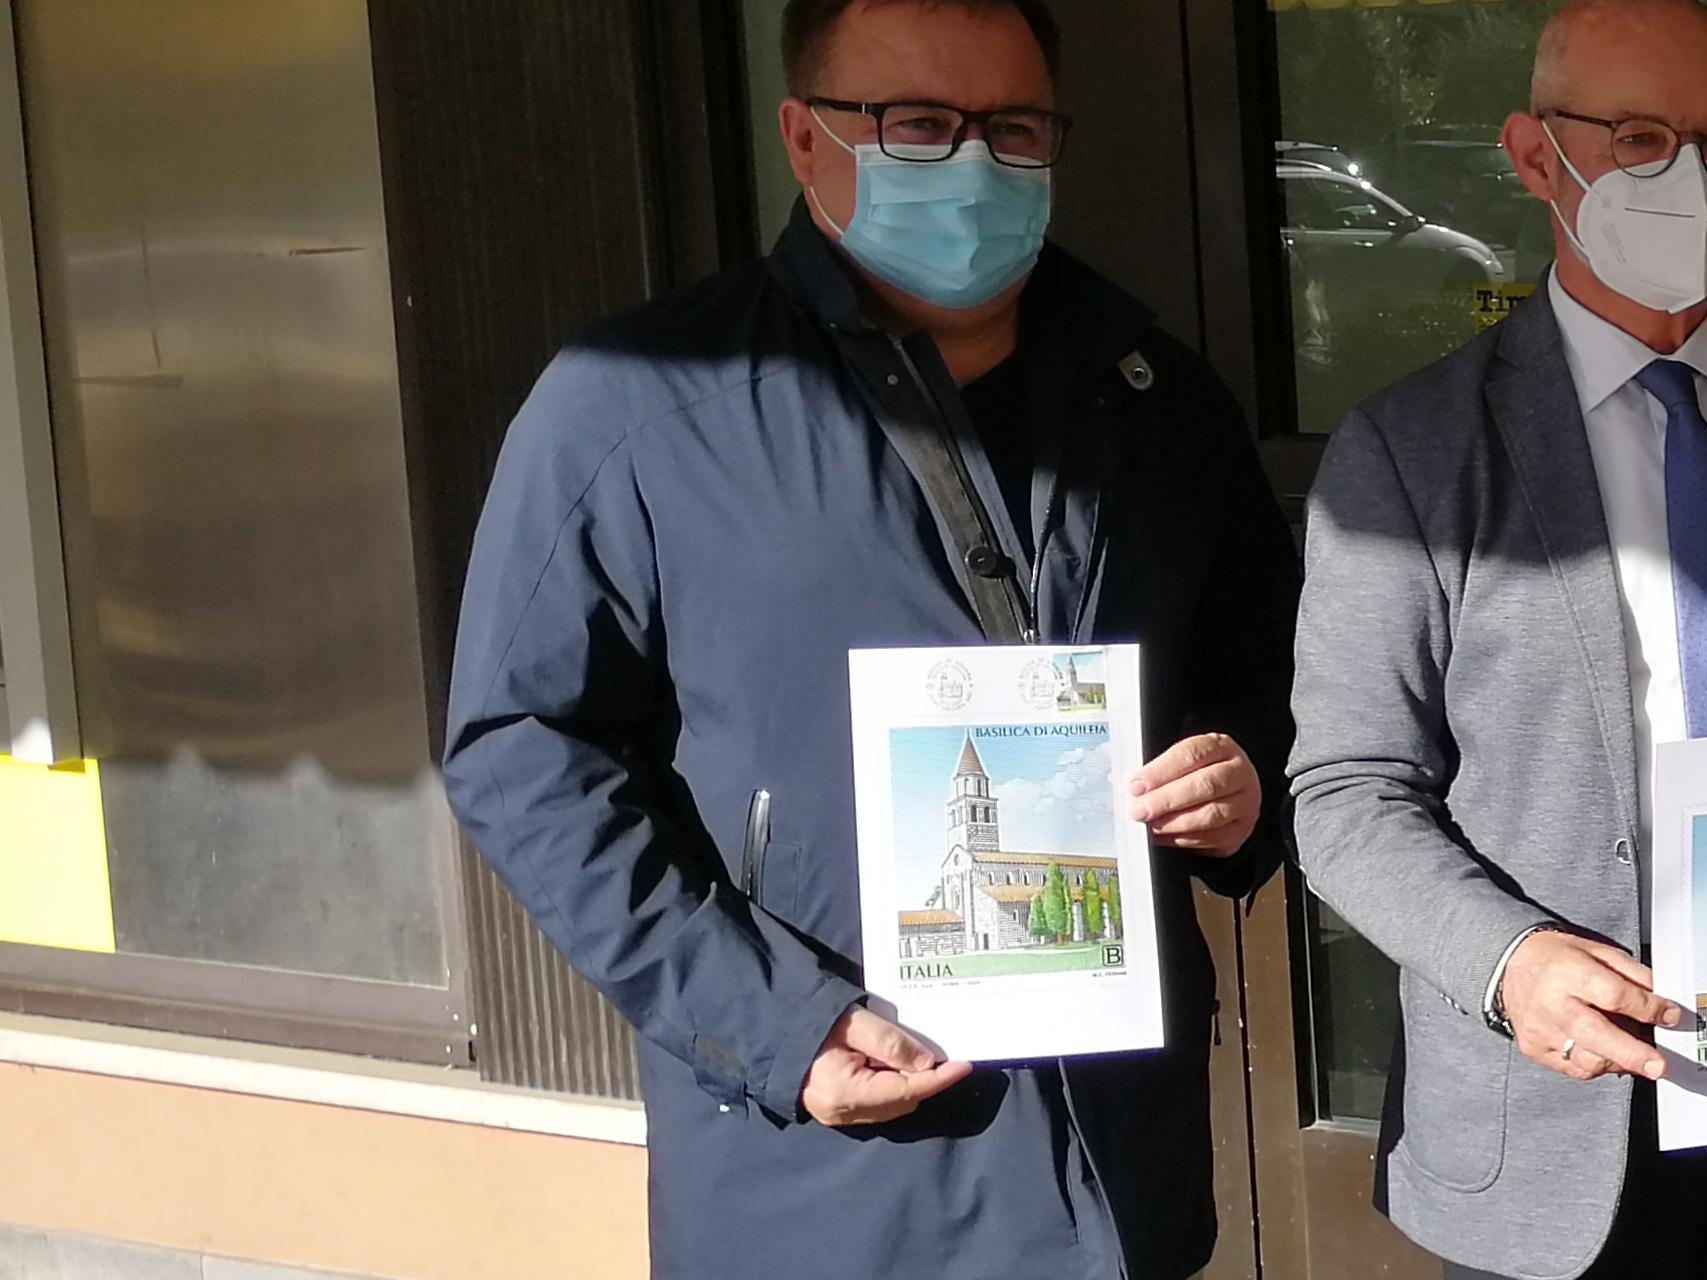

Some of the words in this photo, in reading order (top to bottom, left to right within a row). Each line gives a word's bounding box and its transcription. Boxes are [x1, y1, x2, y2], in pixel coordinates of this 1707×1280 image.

[975, 726, 1031, 738] BASILICA
[1034, 725, 1048, 737] DI
[1050, 723, 1107, 738] AQUILEIA
[1105, 948, 1122, 965] B
[899, 962, 954, 980] ITALIA
